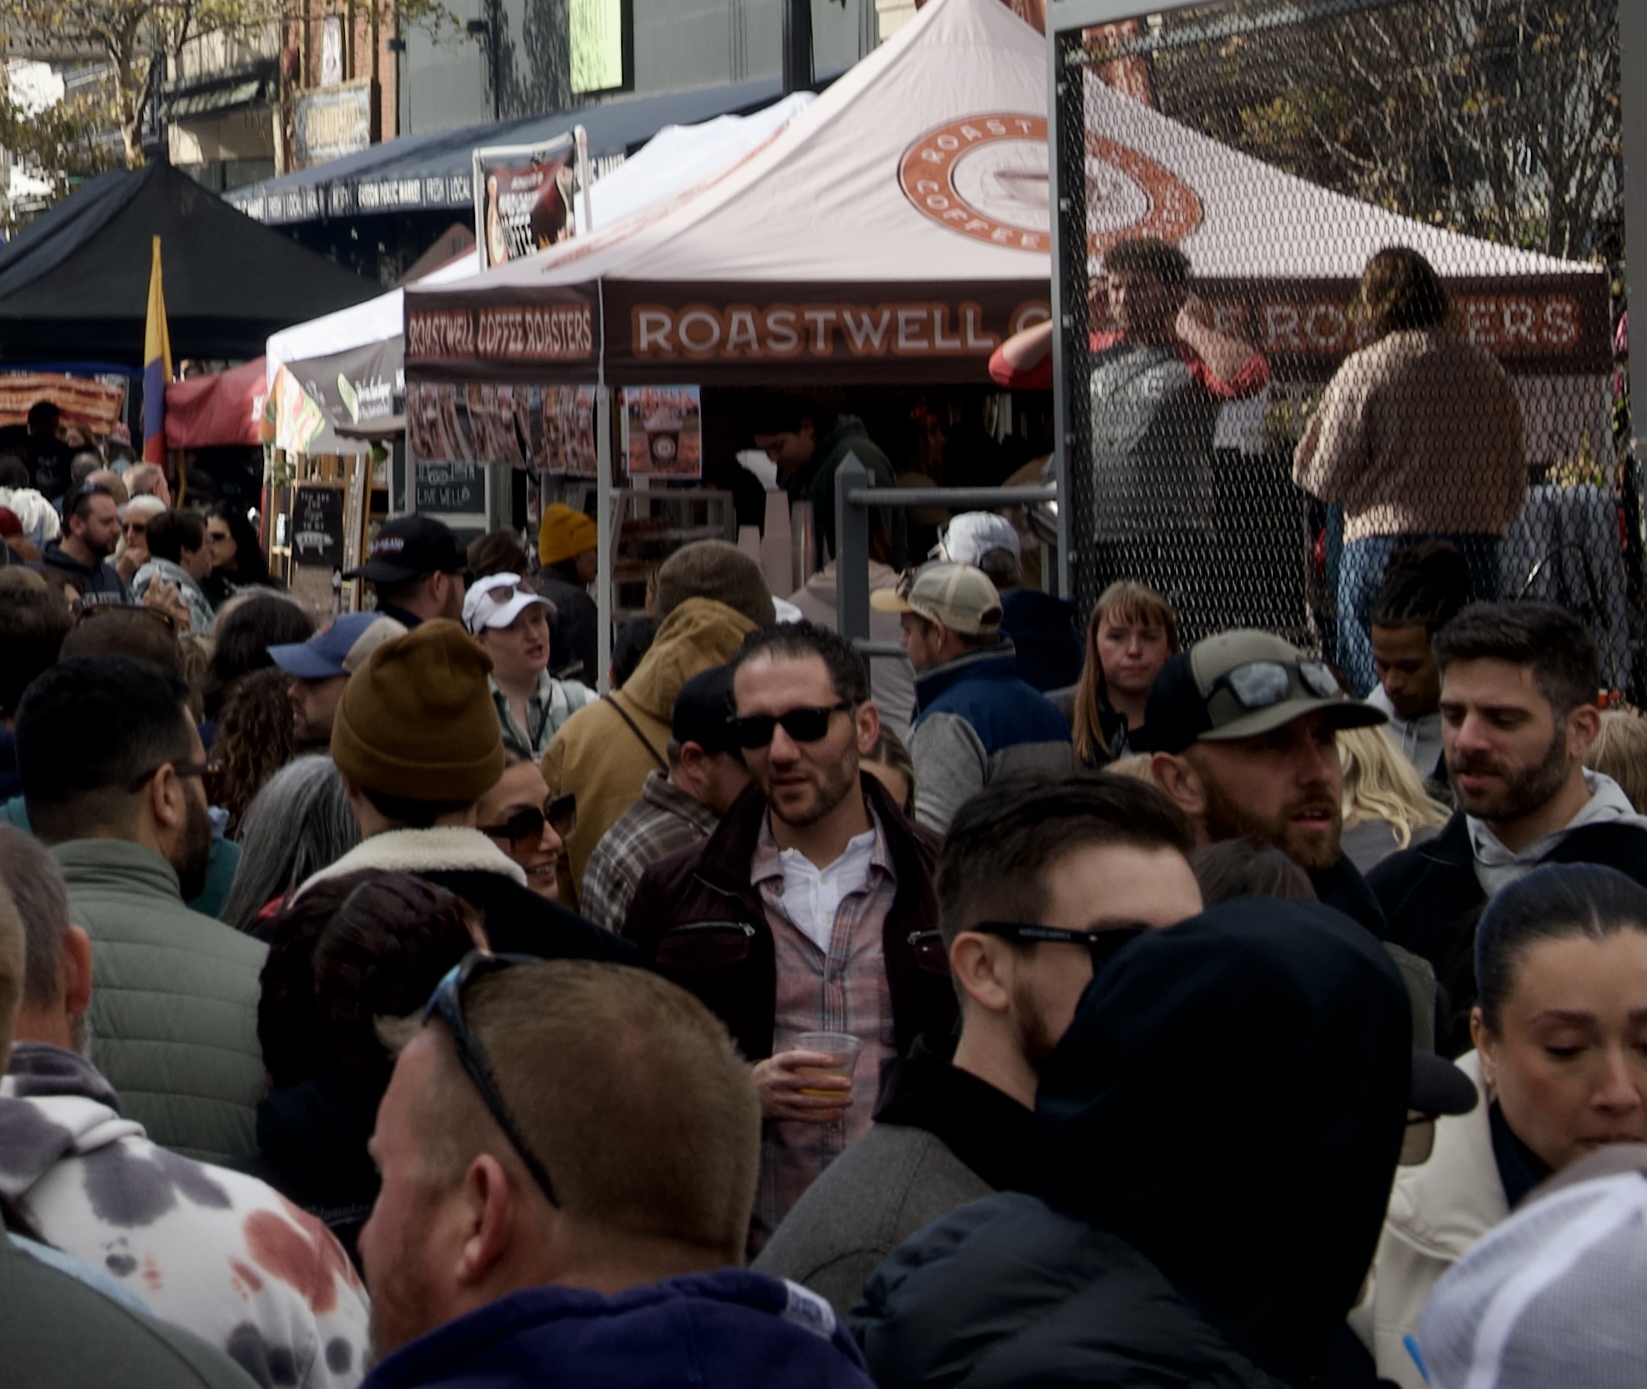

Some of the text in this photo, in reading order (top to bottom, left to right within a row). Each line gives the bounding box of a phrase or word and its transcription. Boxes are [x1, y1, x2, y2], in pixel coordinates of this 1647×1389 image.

[450, 175, 471, 202] LOCAL
[409, 309, 592, 354] ROASTWELL COFFEE ROASTERS
[638, 309, 995, 353] ROASTWELL
[1266, 302, 1576, 347] ROERS
